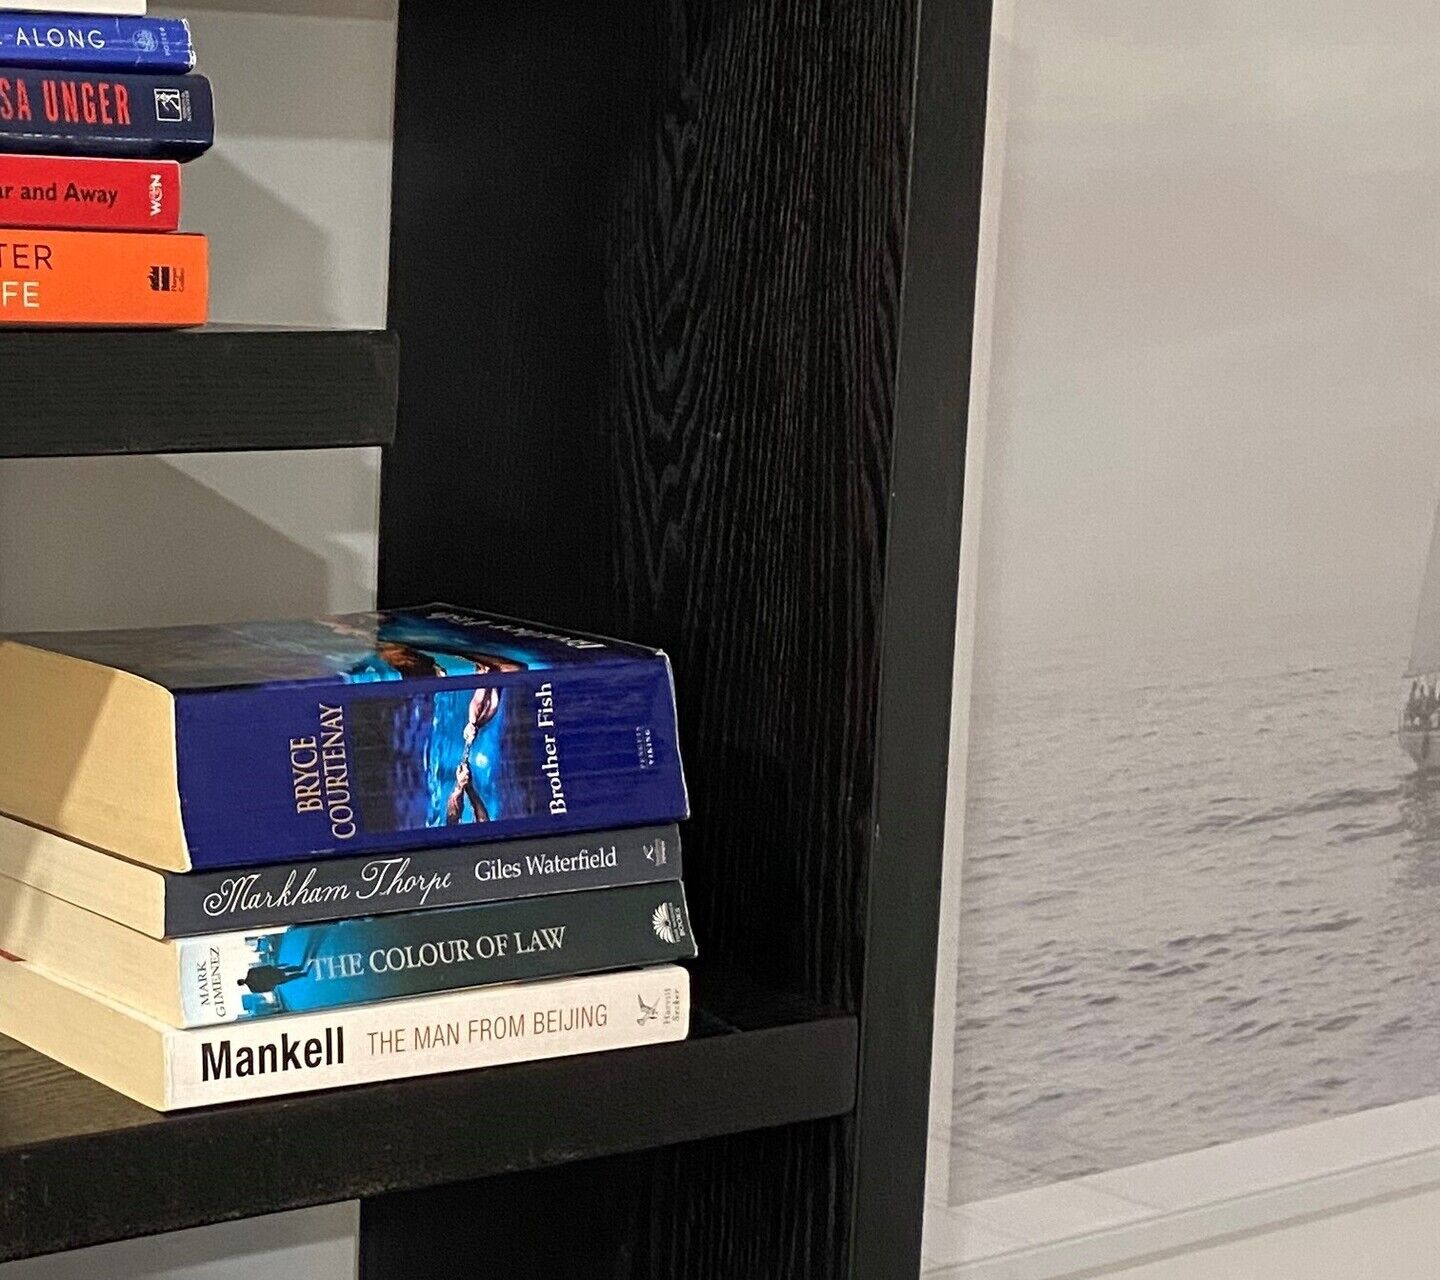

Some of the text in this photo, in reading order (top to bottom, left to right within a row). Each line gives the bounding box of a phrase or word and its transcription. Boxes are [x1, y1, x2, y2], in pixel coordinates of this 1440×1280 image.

[15, 27, 106, 49] ALONG
[42, 79, 132, 126] UNGER
[19, 180, 57, 202] and
[63, 182, 118, 207] Away
[290, 734, 324, 815] BRYCE
[318, 703, 356, 840] COURTENAY
[534, 682, 567, 815] Brother Fish
[203, 857, 453, 917] Markham Thorpe
[475, 846, 618, 883] Giles Waterfield
[209, 946, 227, 1018] GIMENEZ
[307, 926, 567, 982] THE COLOUR OF LAW
[198, 961, 211, 1006] MARK
[200, 1025, 345, 1083] Mankell
[367, 1003, 608, 1058] THE MAN FROM BEIJING
